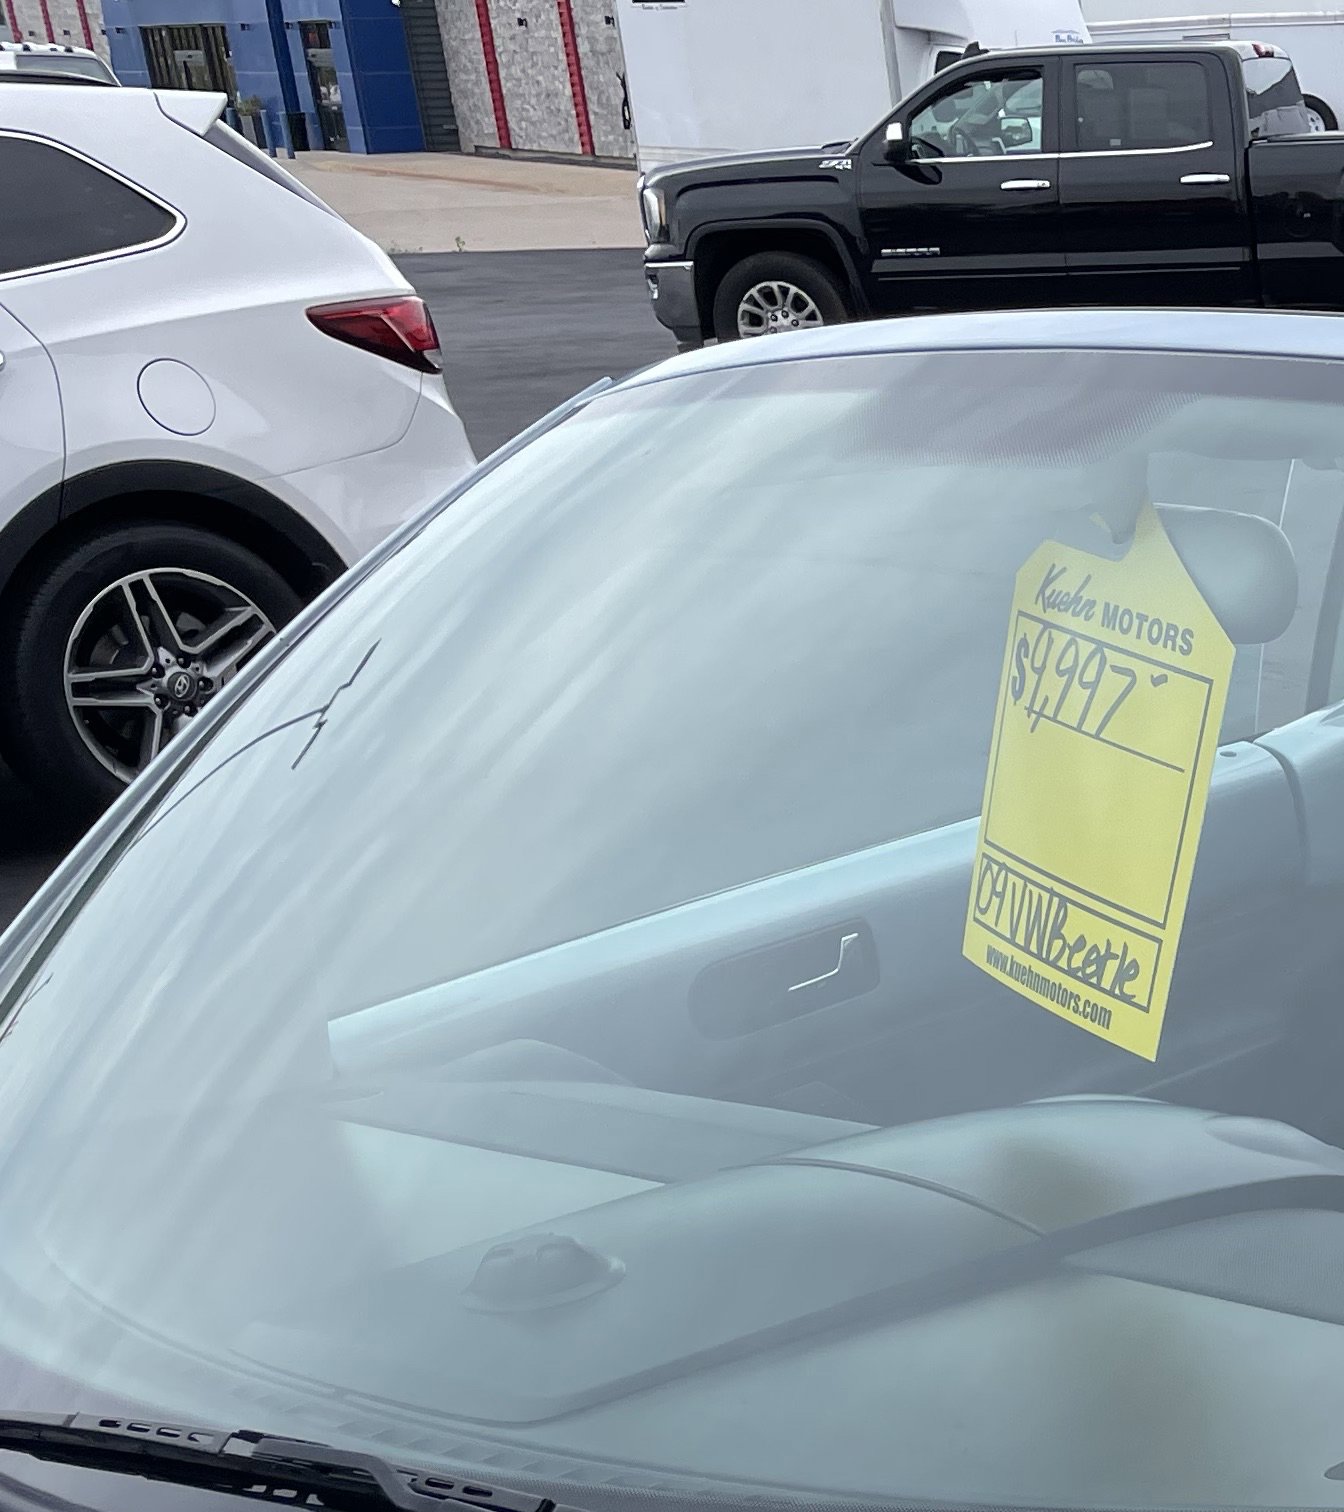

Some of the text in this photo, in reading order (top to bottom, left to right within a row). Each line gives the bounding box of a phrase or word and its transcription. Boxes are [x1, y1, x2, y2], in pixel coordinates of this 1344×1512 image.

[1035, 563, 1195, 656] Kuehn MOTORS
[986, 944, 1113, 1030] www.kuehnmotors.com
